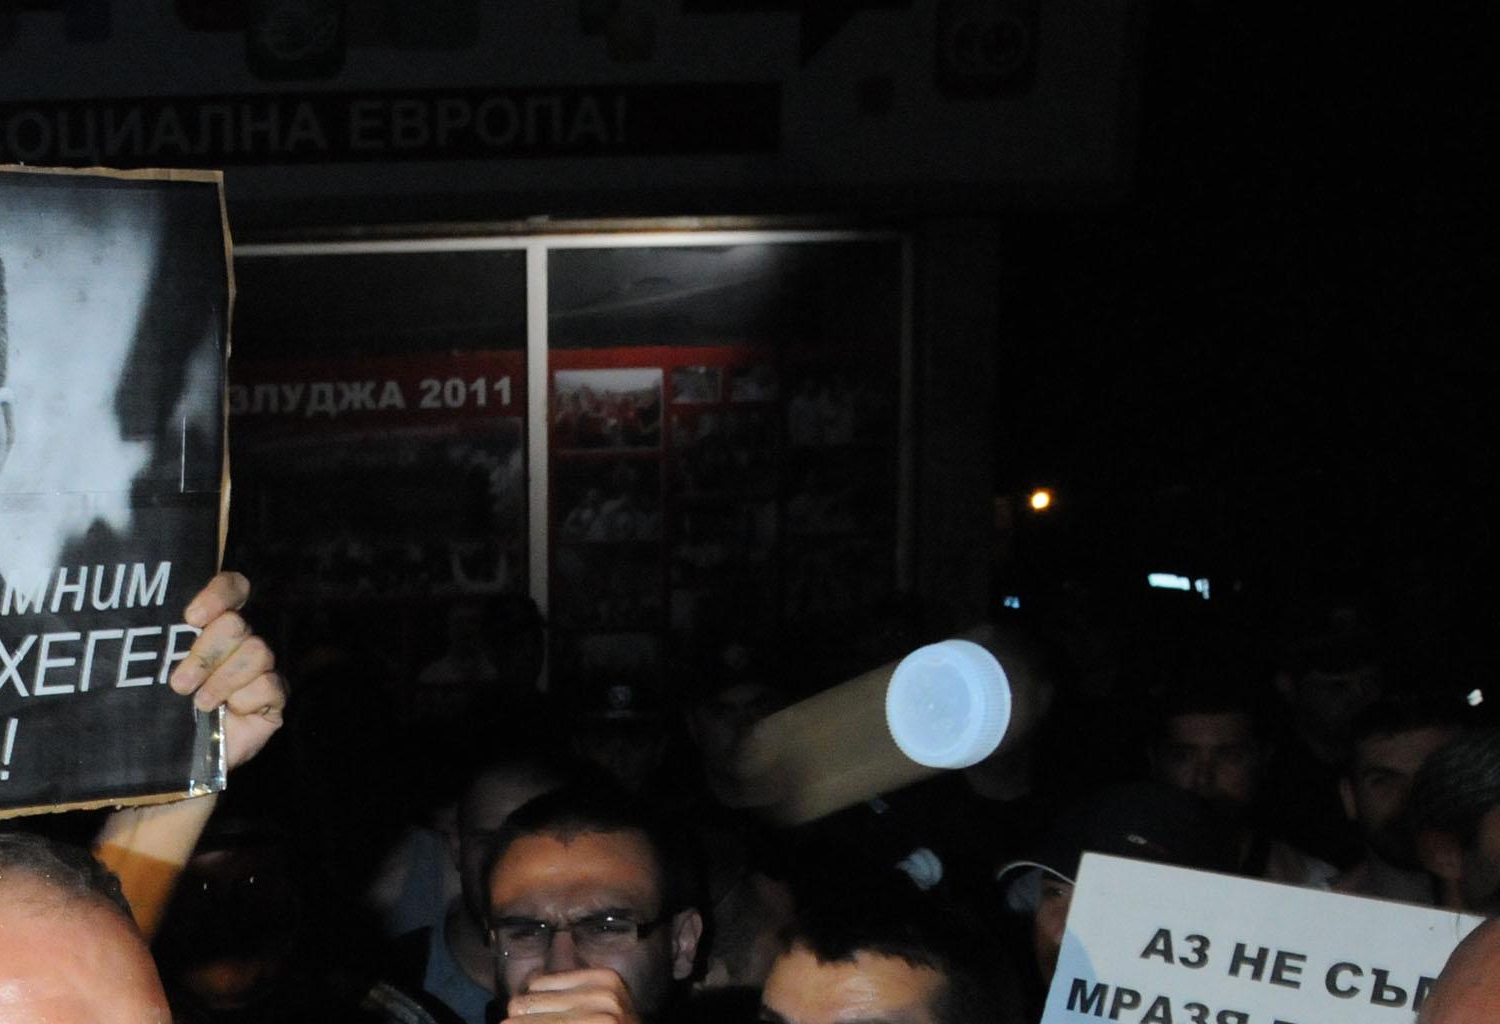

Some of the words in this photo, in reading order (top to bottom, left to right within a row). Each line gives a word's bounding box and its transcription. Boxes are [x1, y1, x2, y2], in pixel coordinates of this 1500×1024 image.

[348, 96, 627, 151] ЕВРОПА!
[419, 375, 513, 411] 2011
[1140, 928, 1211, 969] АЗ
[1228, 942, 1308, 989] НЕ
